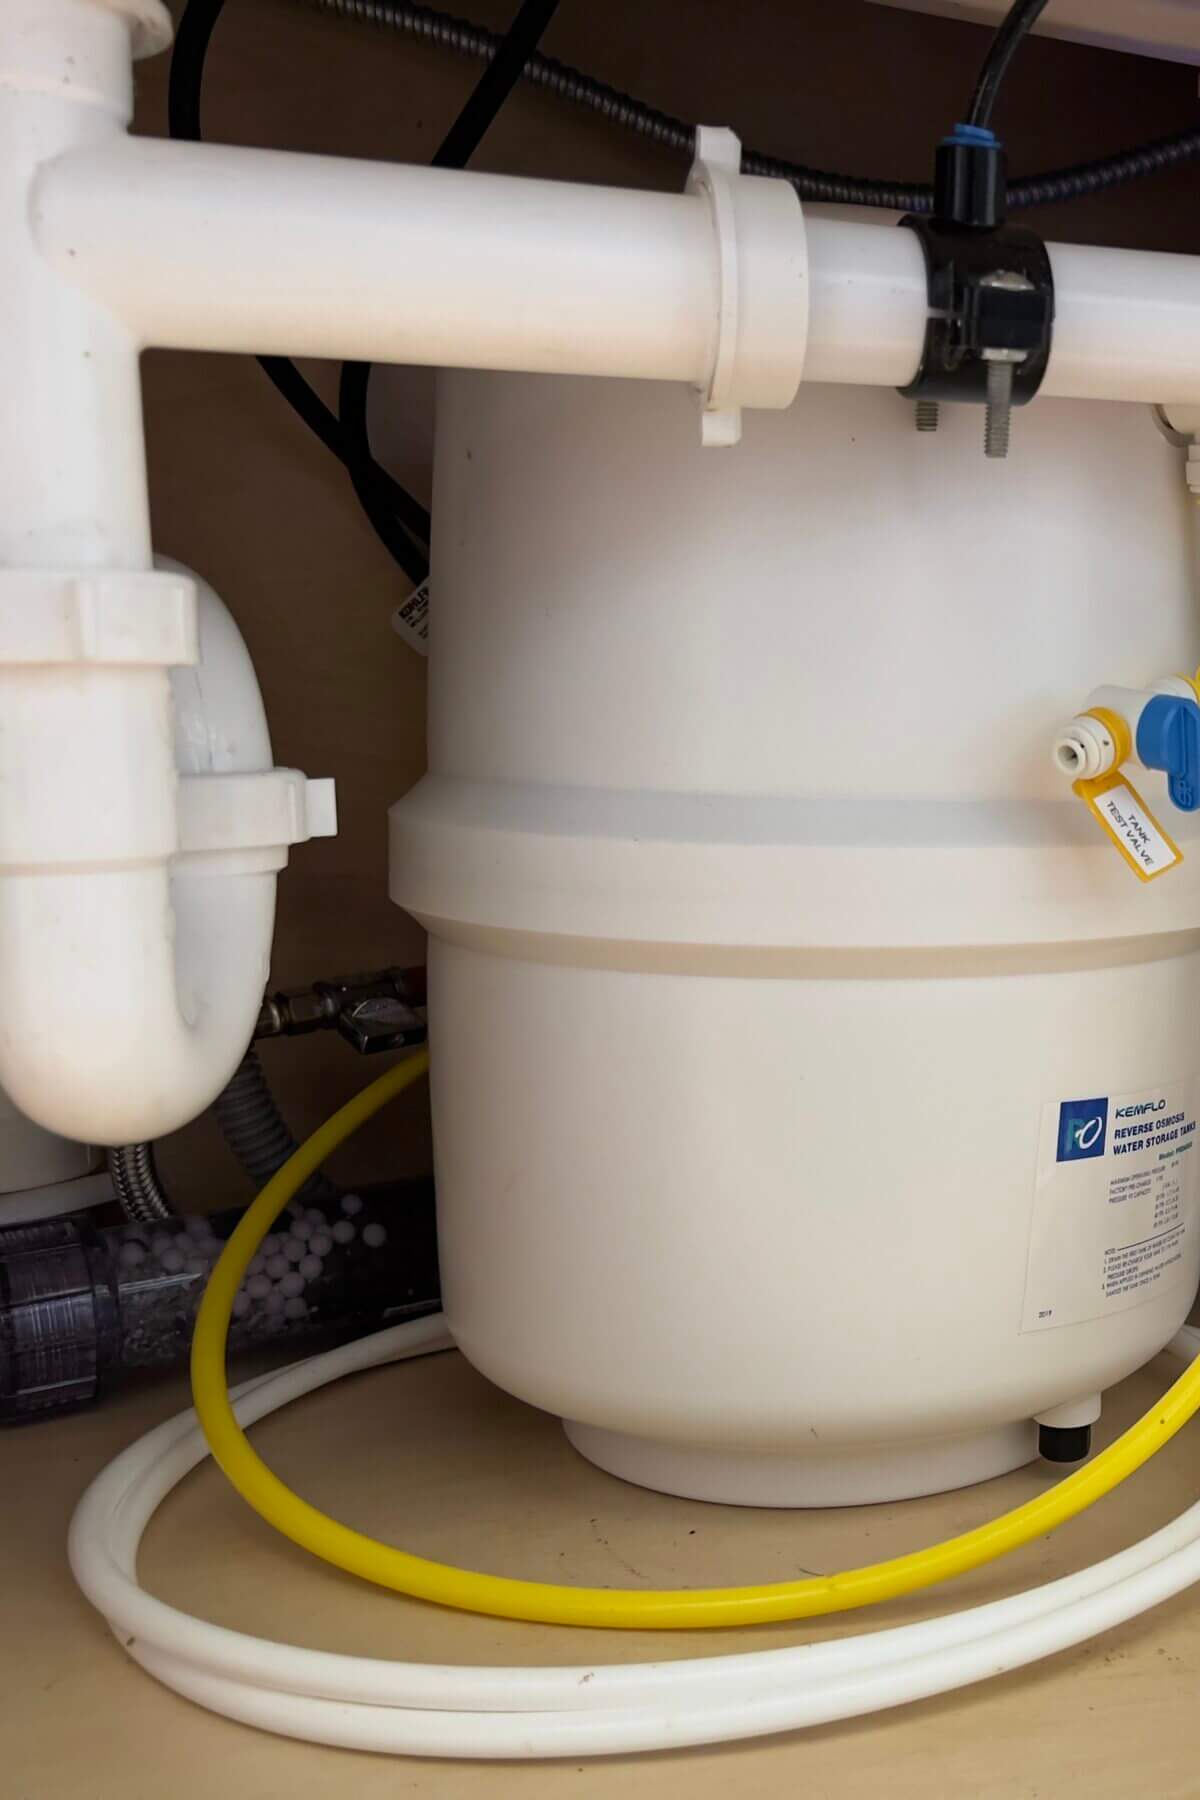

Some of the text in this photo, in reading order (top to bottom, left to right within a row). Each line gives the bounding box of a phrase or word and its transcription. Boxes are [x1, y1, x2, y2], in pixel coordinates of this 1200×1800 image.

[1106, 801, 1154, 867] TEST VALVE
[1127, 814, 1151, 843] TANK
[1115, 1099, 1167, 1119] KEMFLO
[1114, 1112, 1185, 1140] REVERSE OSMOSIS
[1112, 1140, 1144, 1156] WATER
[1145, 1129, 1179, 1148] STORAGE
